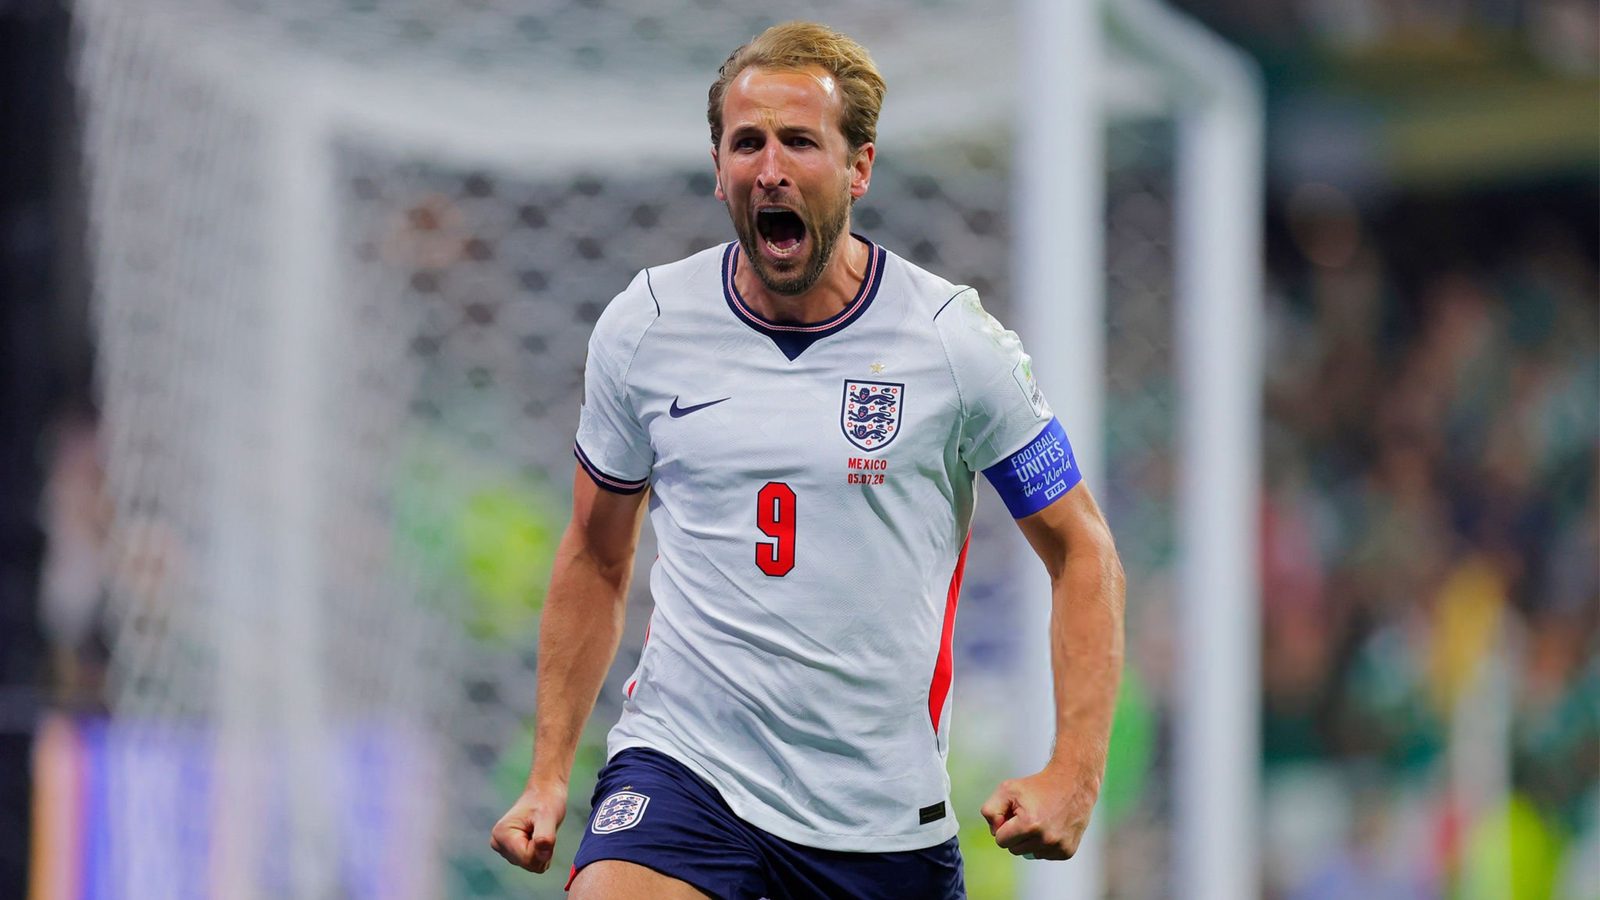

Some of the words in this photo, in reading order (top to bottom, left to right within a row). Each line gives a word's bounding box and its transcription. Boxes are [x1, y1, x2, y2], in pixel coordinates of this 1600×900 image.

[848, 457, 887, 470] MEXICO
[1011, 431, 1057, 469] FOOTBALL
[1016, 441, 1065, 482] UNITES
[848, 473, 885, 485] 05.07.26
[1023, 481, 1043, 498] the
[1042, 454, 1072, 486] World
[1046, 481, 1065, 499] FIFA
[755, 481, 796, 577] 9
